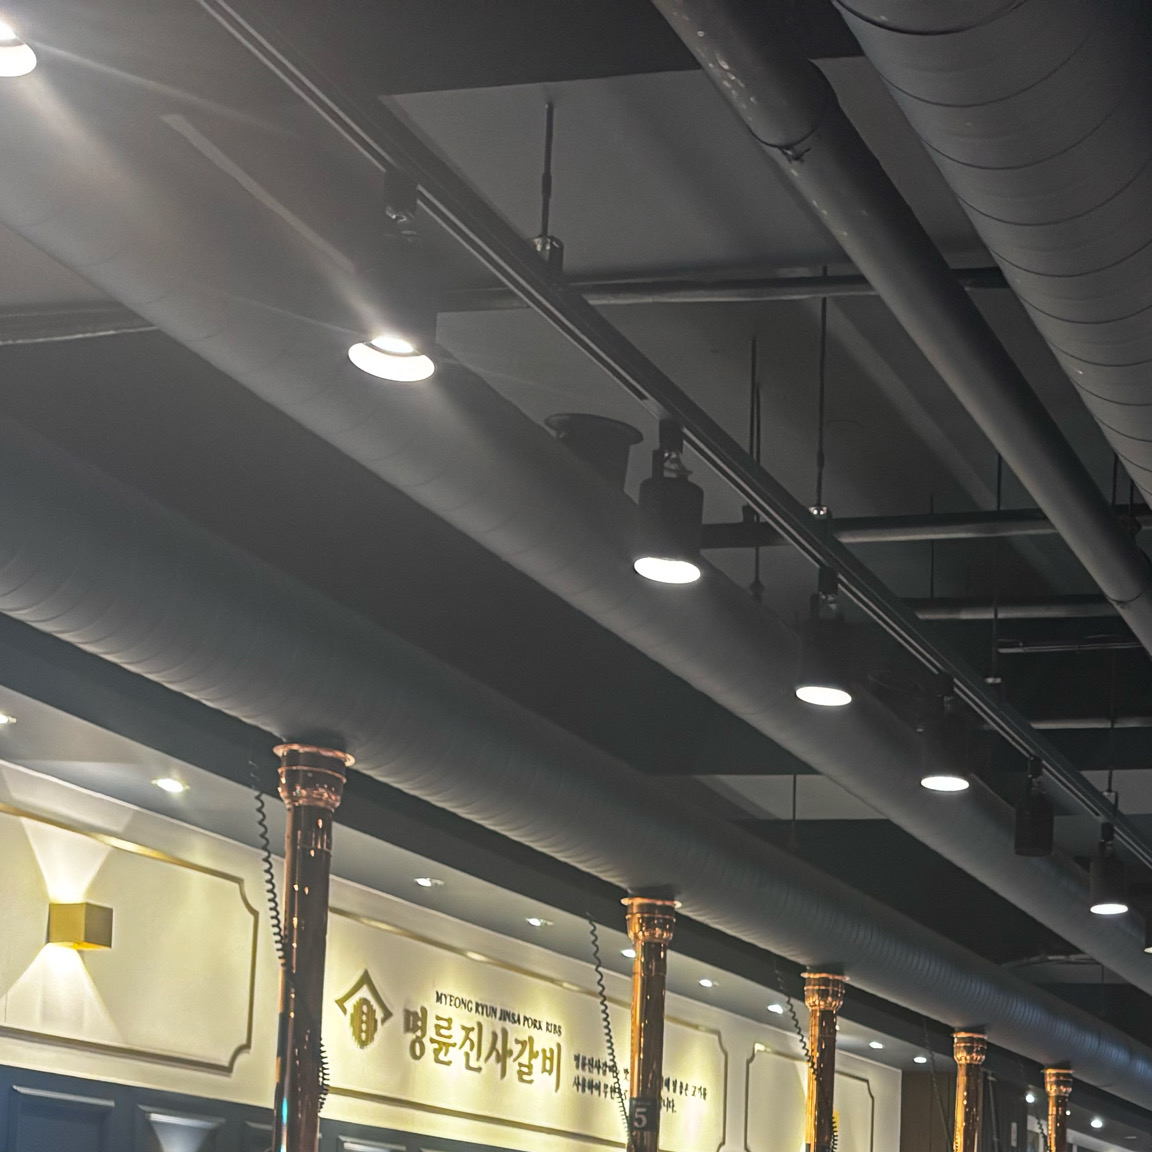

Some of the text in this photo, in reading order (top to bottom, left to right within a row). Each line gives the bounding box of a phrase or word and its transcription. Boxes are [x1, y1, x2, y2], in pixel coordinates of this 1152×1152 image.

[435, 990, 562, 1037] MYEONG RYUN JINSA PORK RIBS
[403, 1006, 562, 1093] 명륜진사갈비
[633, 1107, 648, 1129] 5
